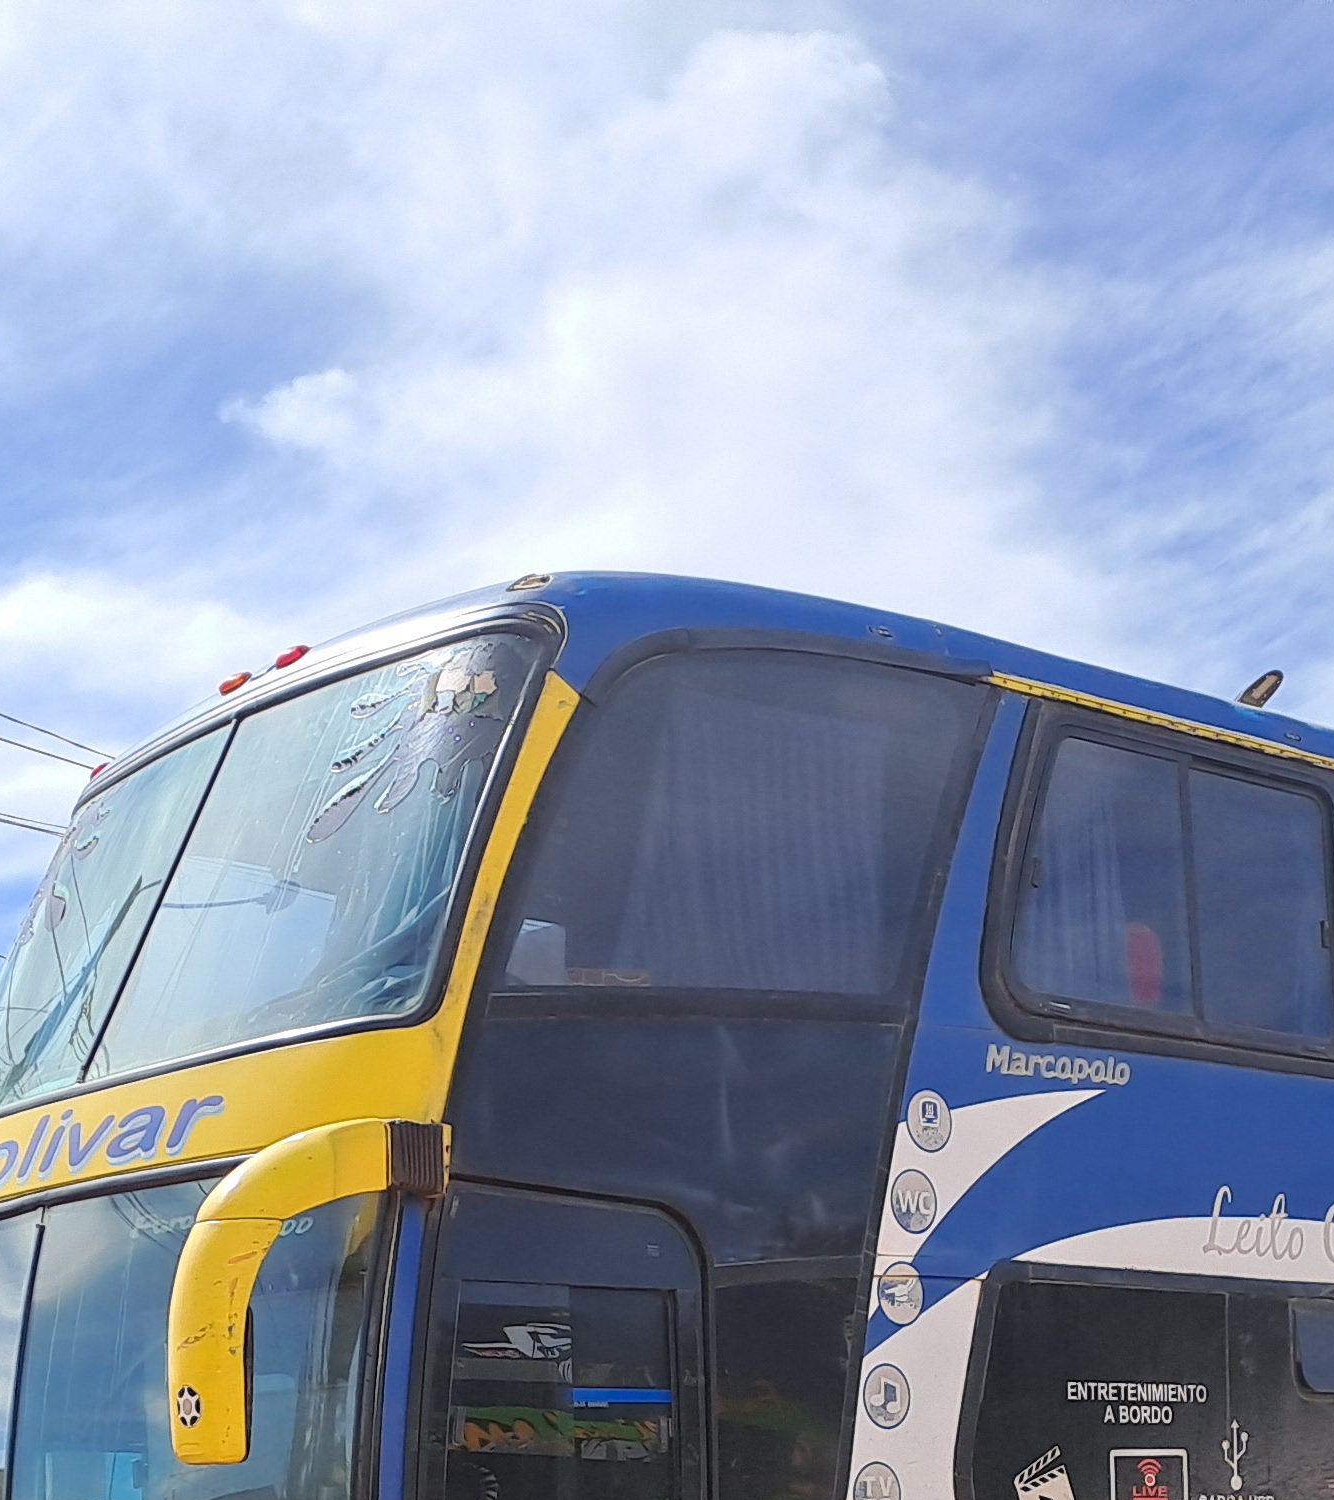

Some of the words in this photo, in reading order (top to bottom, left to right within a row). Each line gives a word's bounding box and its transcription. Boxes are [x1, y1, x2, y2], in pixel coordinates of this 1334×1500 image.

[986, 1043, 1131, 1086] Marcopolo
[897, 1189, 931, 1215] WC
[1202, 1184, 1304, 1261] Leito
[1067, 1381, 1207, 1404] ENTRETENIMIENTO
[1104, 1405, 1116, 1425] A
[1119, 1405, 1174, 1425] BORDO
[862, 1475, 894, 1497] TV
[1132, 1485, 1168, 1498] LIVE
